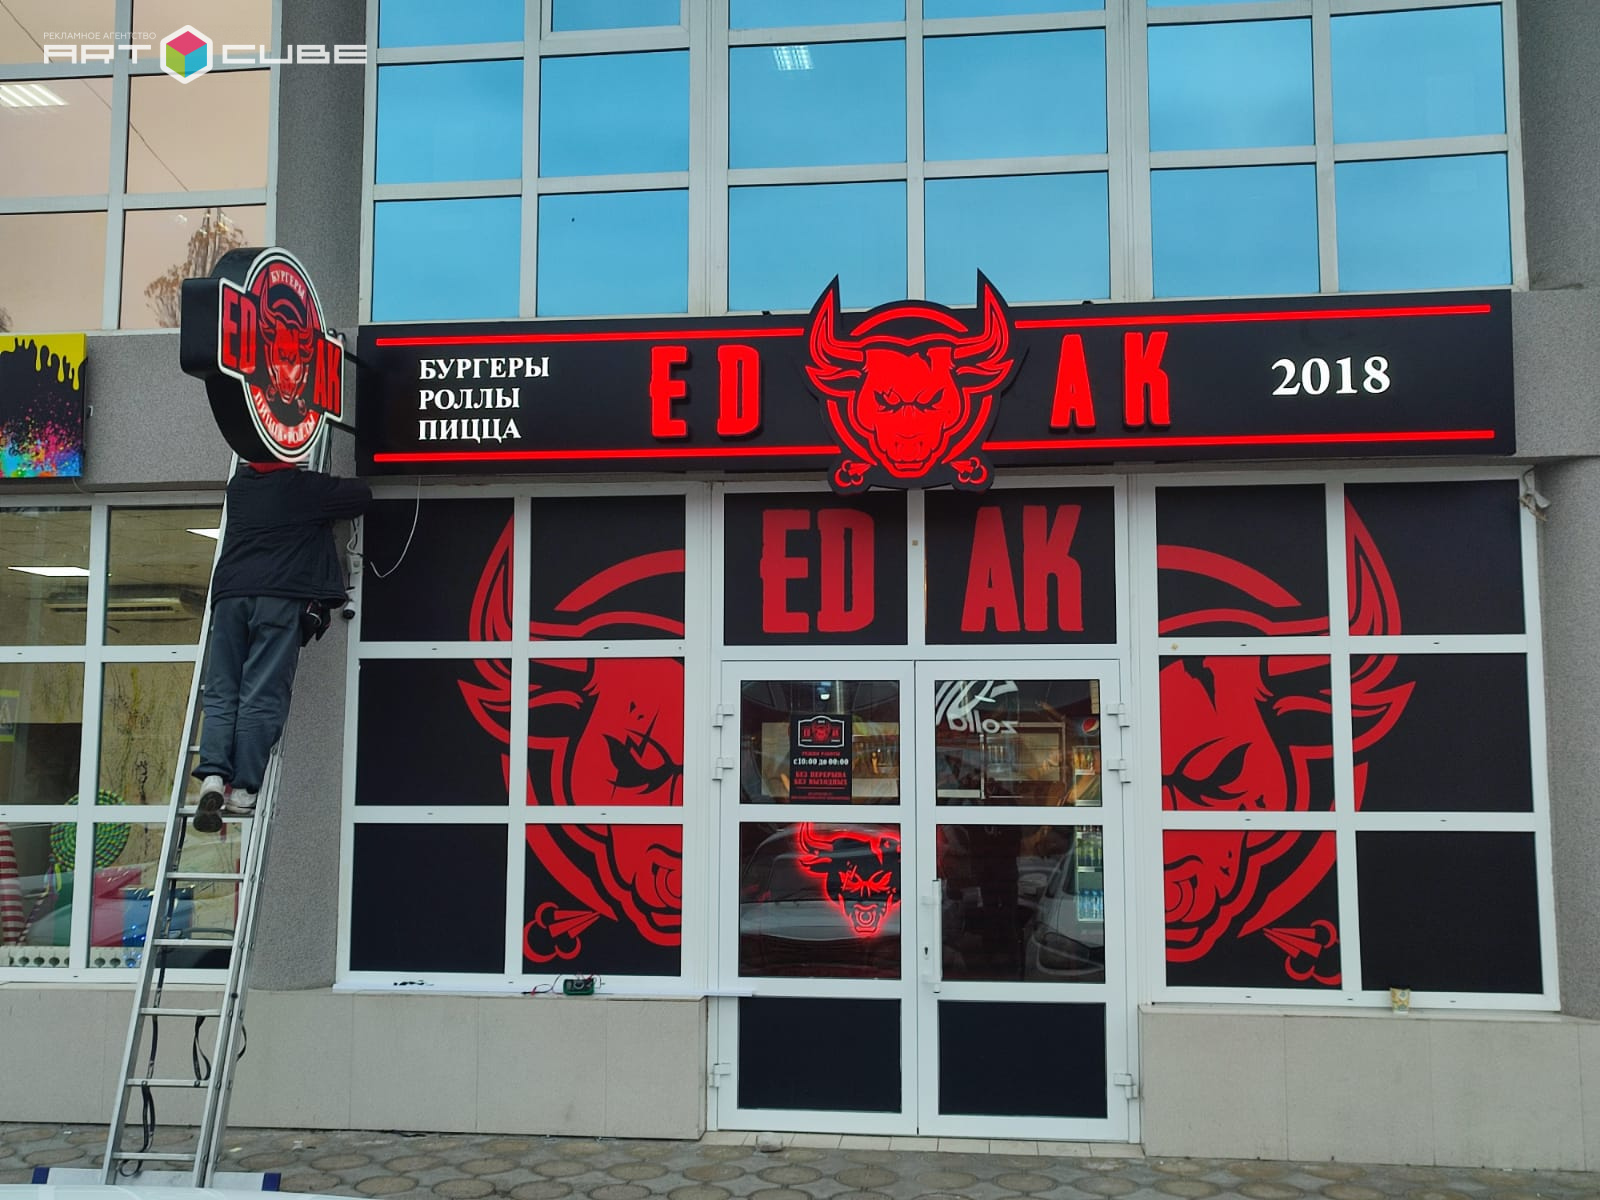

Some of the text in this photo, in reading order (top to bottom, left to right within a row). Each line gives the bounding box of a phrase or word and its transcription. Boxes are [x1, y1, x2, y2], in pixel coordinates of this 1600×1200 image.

[270, 269, 306, 299] БУРГЕРЫ
[222, 287, 341, 414] ED AK
[419, 356, 550, 380] БУРГЕРЫ
[650, 345, 761, 437] ED
[1271, 356, 1391, 396] 2018
[418, 387, 521, 410] РОЛЛЫ
[418, 418, 522, 443] ПИЦЦА
[760, 504, 1084, 633] ED AK
